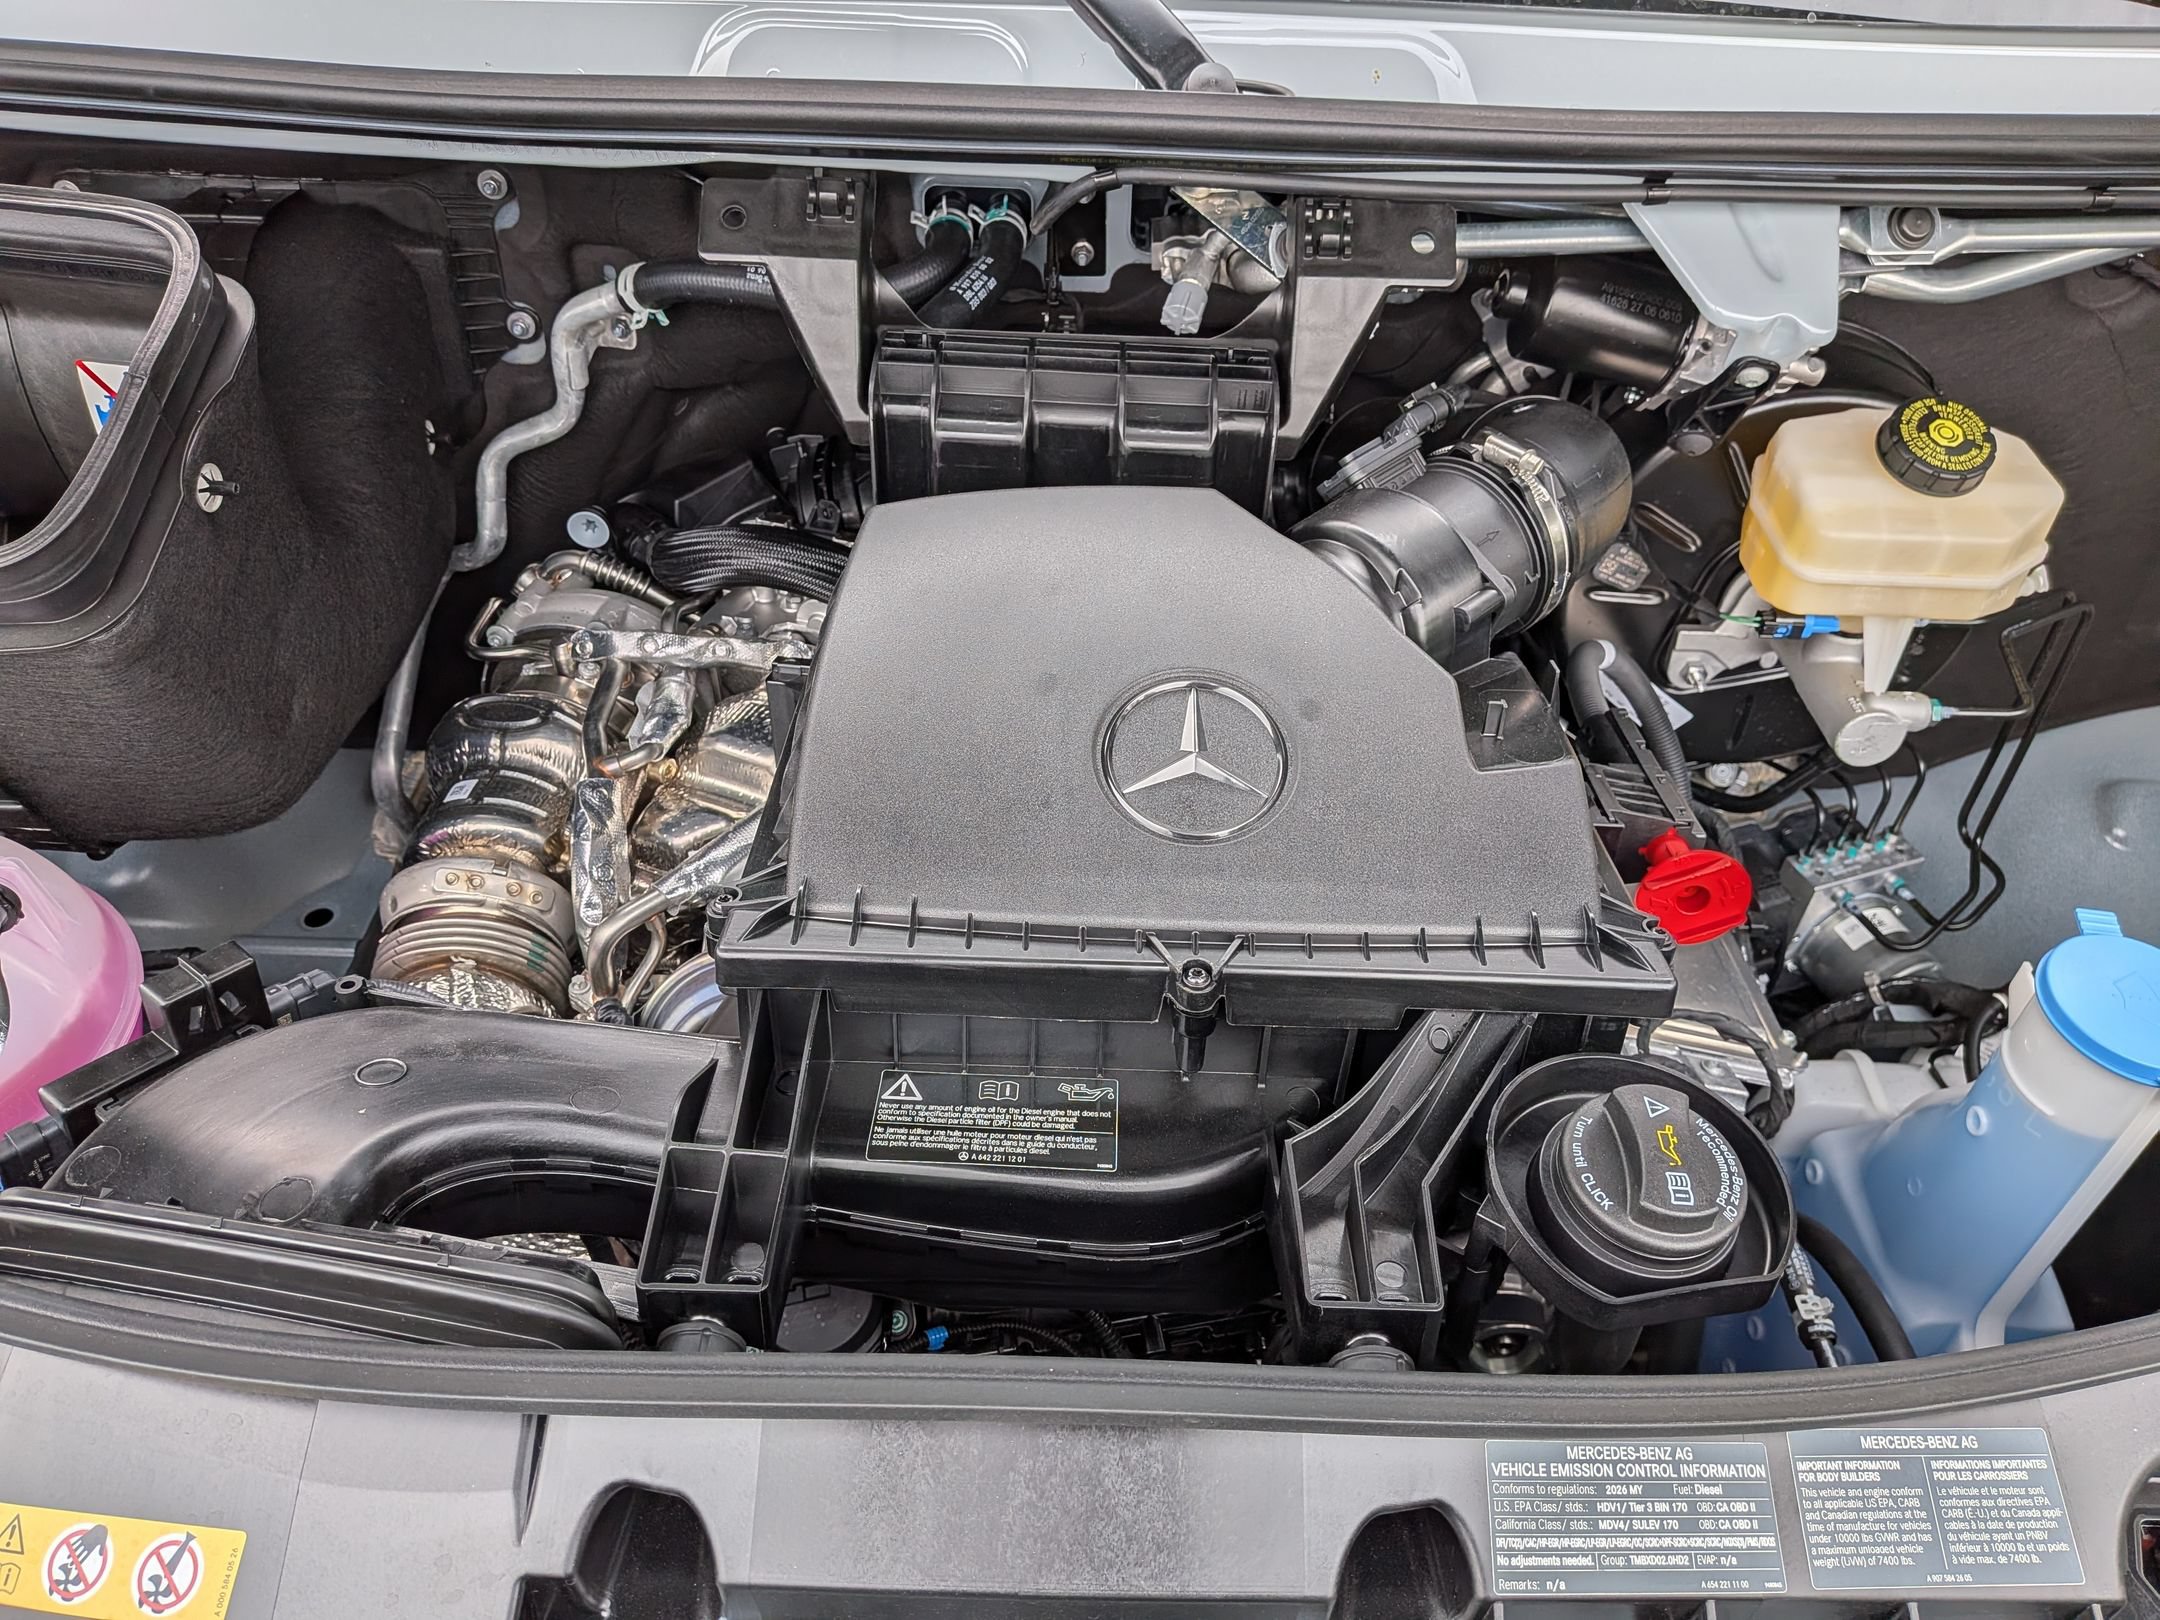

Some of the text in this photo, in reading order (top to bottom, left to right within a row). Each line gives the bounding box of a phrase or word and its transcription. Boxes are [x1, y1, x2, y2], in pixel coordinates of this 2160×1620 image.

[1630, 302, 1642, 312] 27
[1948, 401, 1963, 410] NUR
[1923, 448, 1949, 462] BEFORE
[1950, 448, 1980, 462] REMOVING
[1922, 455, 1941, 467] FROM
[1942, 462, 1947, 470] A
[1948, 463, 1972, 471] SEALED
[964, 1106, 986, 1114] engine
[1043, 1109, 1065, 1117] engine
[1573, 1116, 1616, 1212] Turn until CLICK
[1695, 1117, 1744, 1223] Mercedes-Benz Oil
[1697, 1130, 1730, 1208] recommended
[1860, 1436, 1978, 1448] MERCEDES-BENZ AG
[1566, 1446, 1693, 1460] MERCEDES-BENZ AG
[1796, 1460, 1900, 1470] IMPORTANT INFORMATION
[1930, 1459, 2047, 1469] INFORMATIONS IMPORTANTES
[1491, 1463, 1766, 1478] VEHICLE EMISSION CONTROL INFORMATION
[1933, 1471, 2028, 1480] POUR LES CARROSSIERS
[1798, 1472, 1880, 1482] FOR BODY BUILDERS
[1493, 1484, 1722, 1496] Conforms to regulations: 2026 MY Fuel: Diesel
[1801, 1487, 1923, 1498] This vehicle and engine conform
[1494, 1502, 1756, 1514] U.S. EPA Class/ stds.: HDV1/ Tier 3 BIN 170 OBD: CA OBD II
[1803, 1498, 1920, 1510] to all applicable US EPA, CARB
[1805, 1510, 1927, 1521] and Canadian regulations at the
[1495, 1519, 1758, 1531] California Class/ stds.: MDV4/ SULEV 170 OBD: CA OBD II
[1807, 1521, 1932, 1531] time of manufacture for vehicles
[1809, 1532, 1932, 1543] under 10000 lbs GVWR and has
[1818, 1546, 1857, 1555] maximum
[1858, 1545, 1894, 1554] unloaded
[1896, 1544, 1924, 1554] vehicle
[1497, 1555, 1509, 1566] No
[1511, 1555, 1560, 1568] adjustments
[1562, 1555, 1594, 1566] needed.
[1600, 1555, 1628, 1567] Group:
[1697, 1555, 1718, 1565] EVAP:
[1720, 1555, 1737, 1566] n/a
[1813, 1557, 1840, 1568] weight
[1868, 1556, 1877, 1565] of
[1877, 1556, 1899, 1565] 7400
[1901, 1556, 1916, 1565] lbs.
[216, 1592, 226, 1609] 000
[222, 1575, 230, 1590] 584
[226, 1560, 234, 1573] 05
[231, 1547, 238, 1558] 26
[1499, 1578, 1566, 1592] Remarks: n/a
